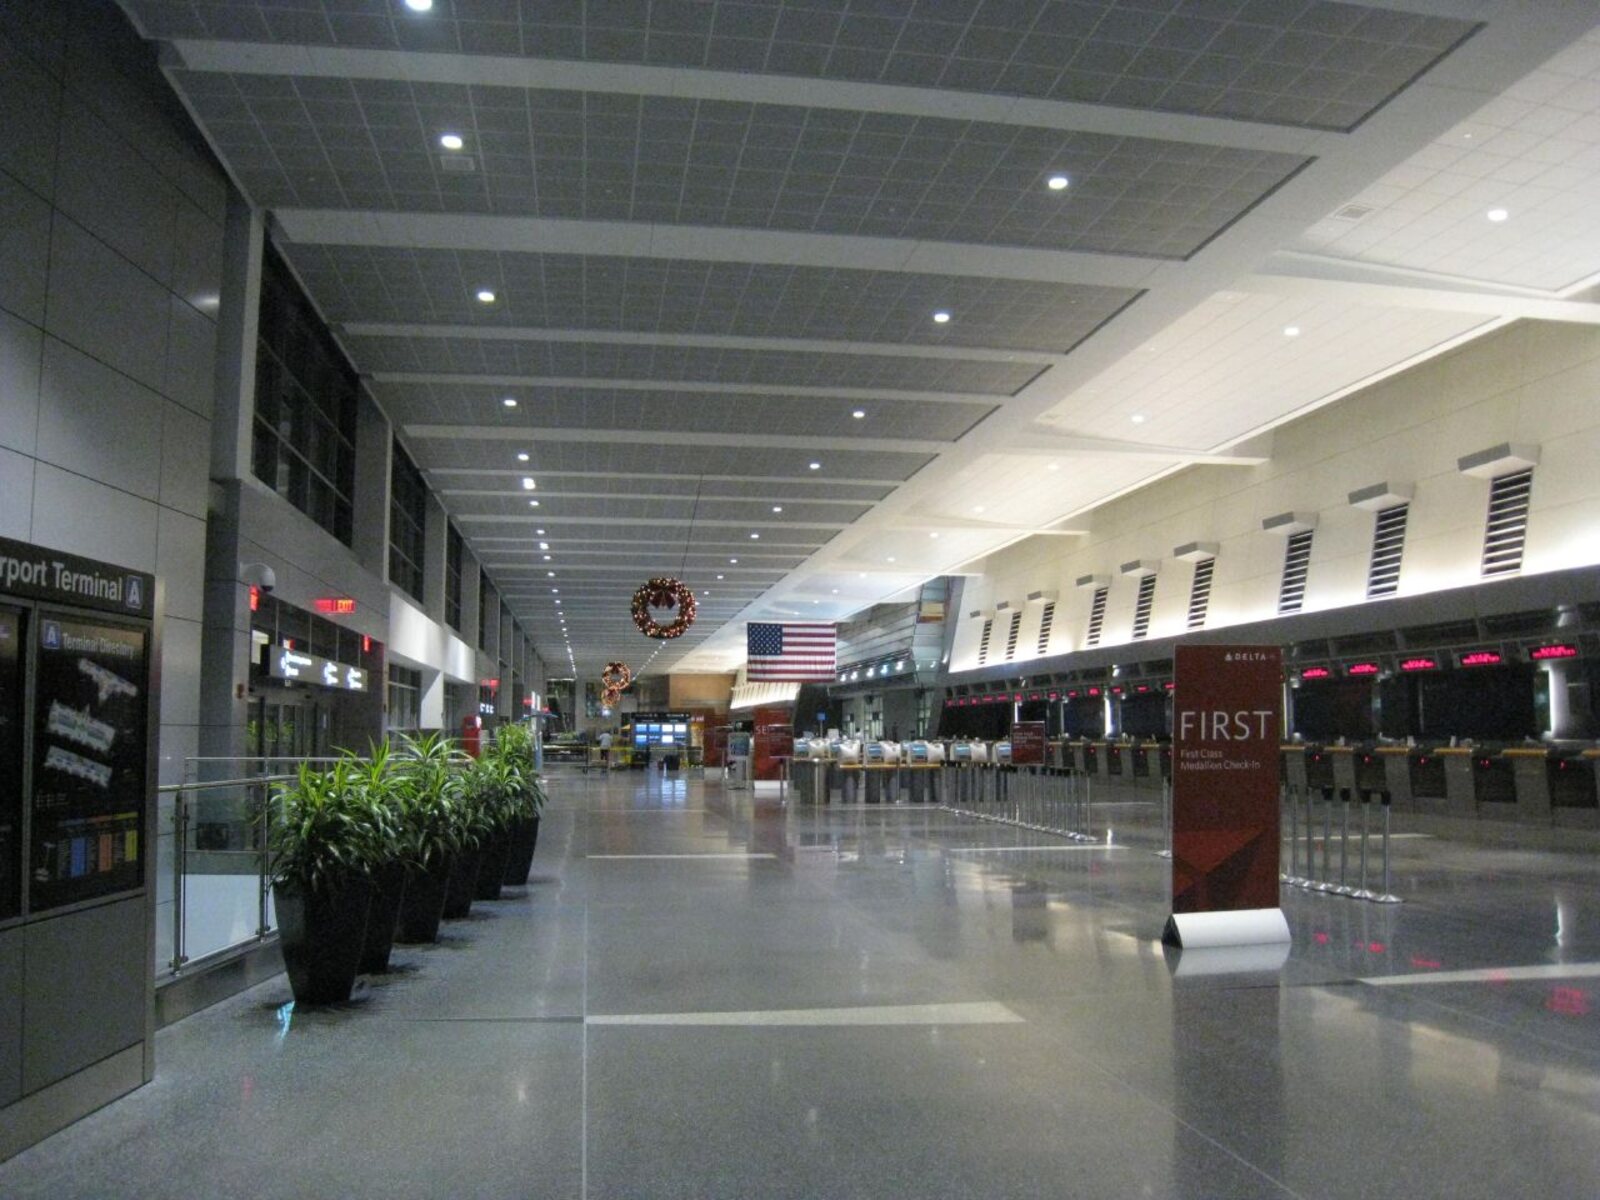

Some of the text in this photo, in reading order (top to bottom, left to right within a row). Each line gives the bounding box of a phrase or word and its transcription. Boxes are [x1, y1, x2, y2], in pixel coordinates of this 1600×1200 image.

[52, 561, 122, 601] Terminal
[129, 580, 140, 605] A
[47, 625, 57, 645] A
[62, 632, 98, 652] Terminal
[1234, 652, 1266, 661] DELTA
[1180, 710, 1273, 741] FIRST
[1180, 749, 1223, 759] First Class
[1180, 759, 1261, 771] Medallion Check-In
